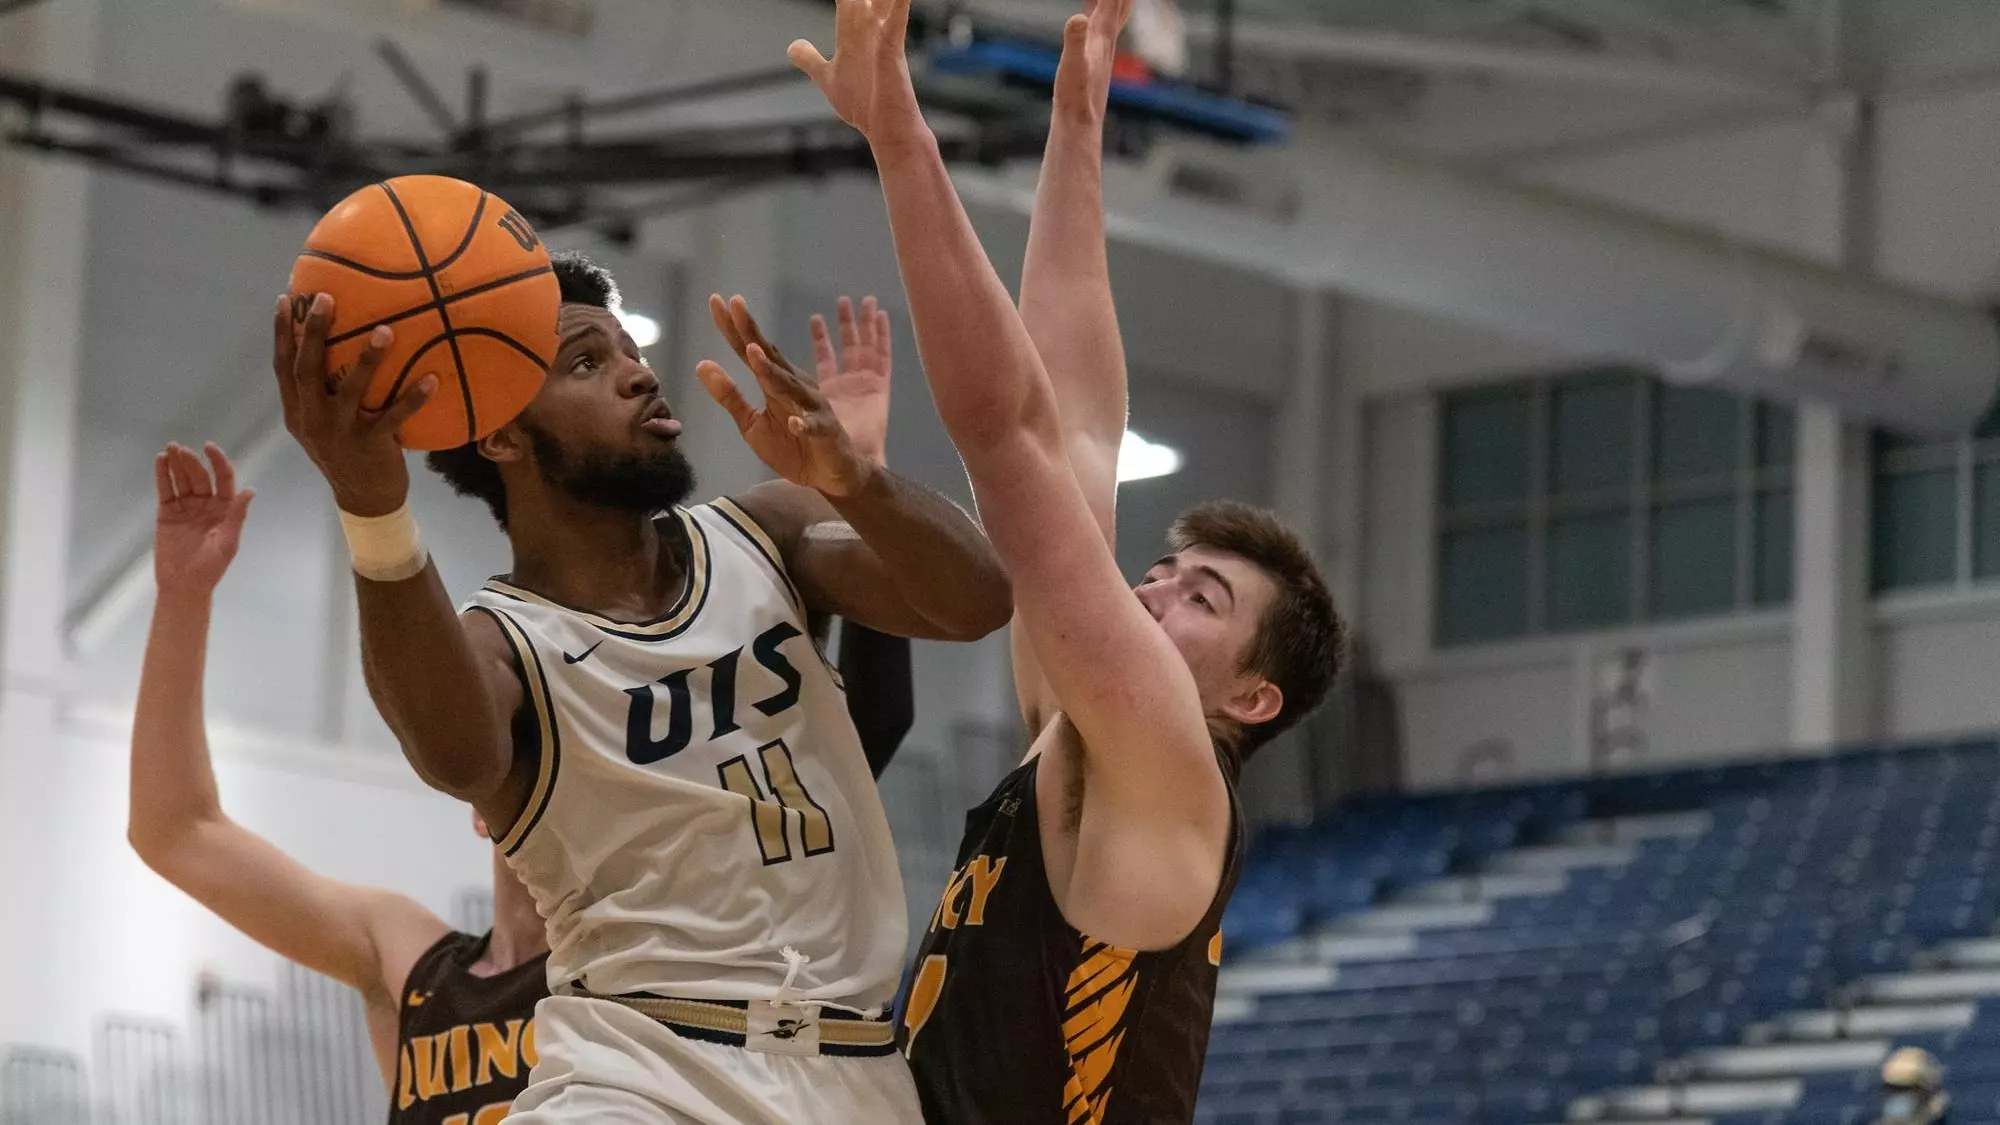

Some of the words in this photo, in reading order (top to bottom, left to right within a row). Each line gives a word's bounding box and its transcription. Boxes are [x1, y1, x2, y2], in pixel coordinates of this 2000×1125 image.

[622, 621, 803, 765] UIS
[717, 737, 835, 866] 11
[931, 855, 1008, 933] CY
